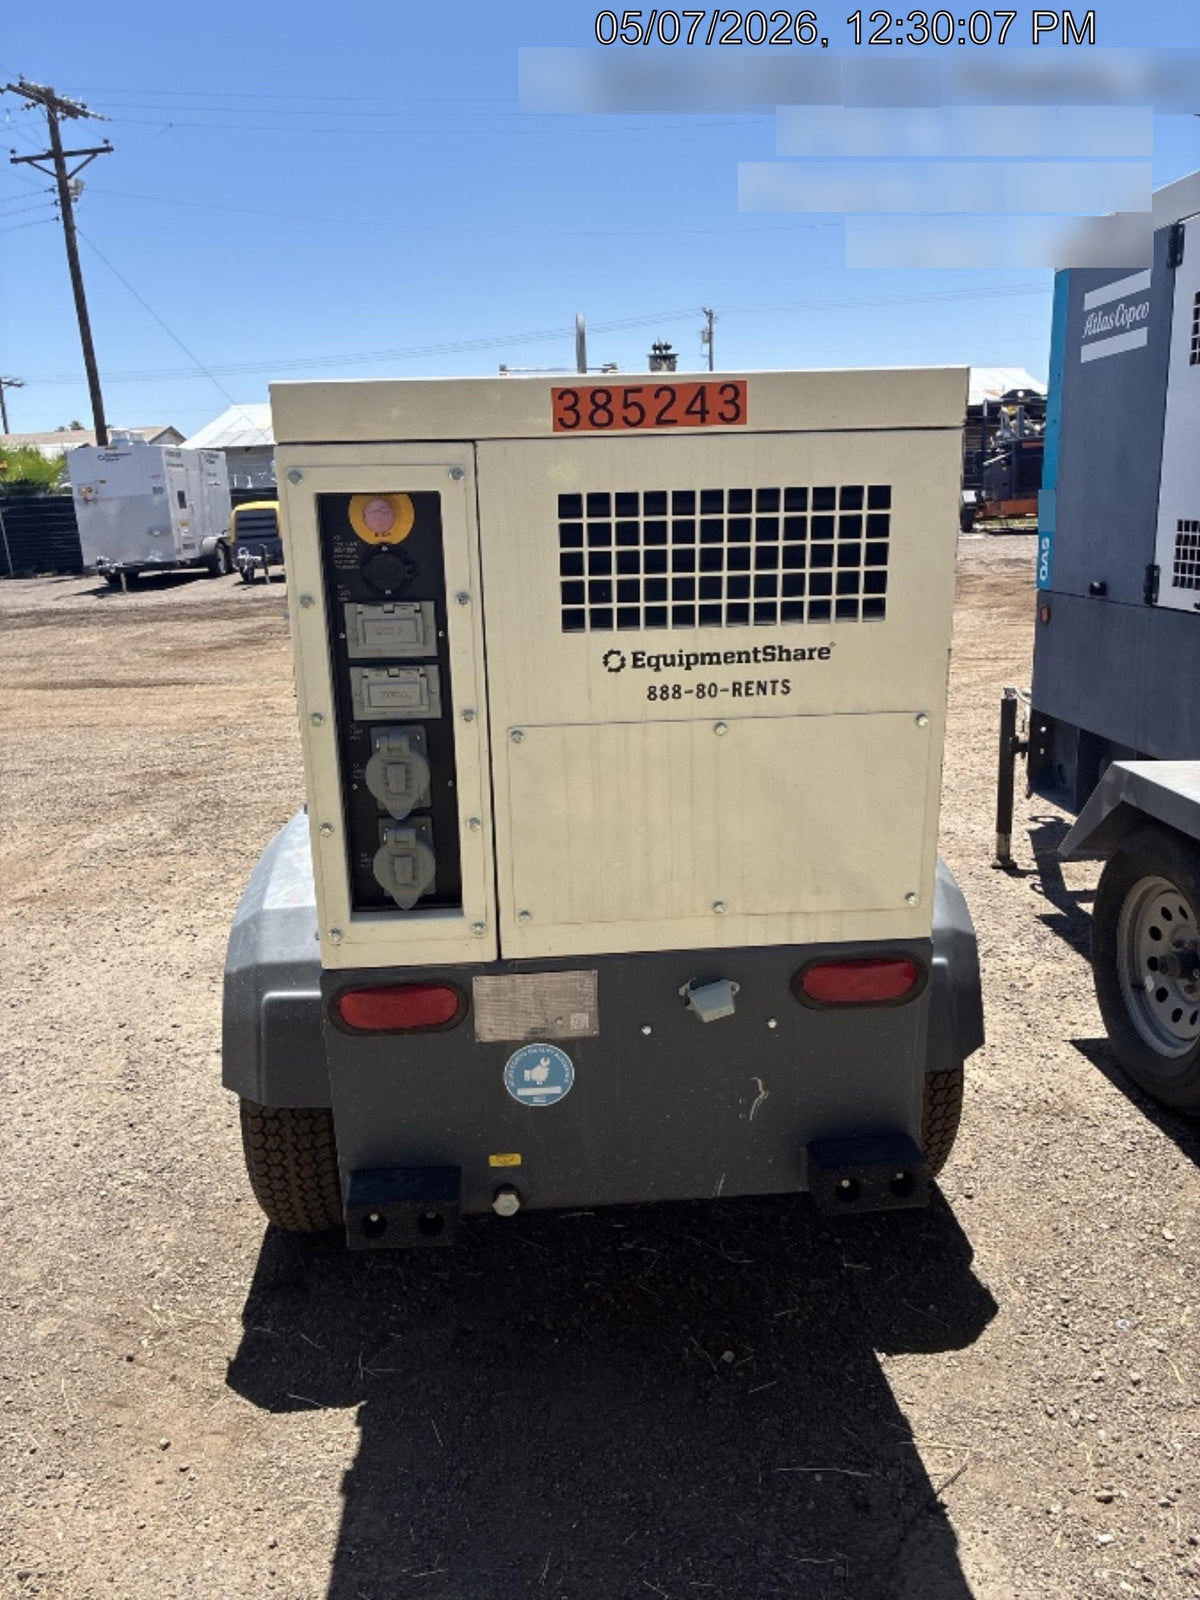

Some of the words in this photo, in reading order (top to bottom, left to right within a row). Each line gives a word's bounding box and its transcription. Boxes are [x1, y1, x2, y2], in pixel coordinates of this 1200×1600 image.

[557, 383, 741, 429] 385243
[631, 644, 832, 672] EquipmentShare
[646, 678, 792, 702] 888-80-RENTS
